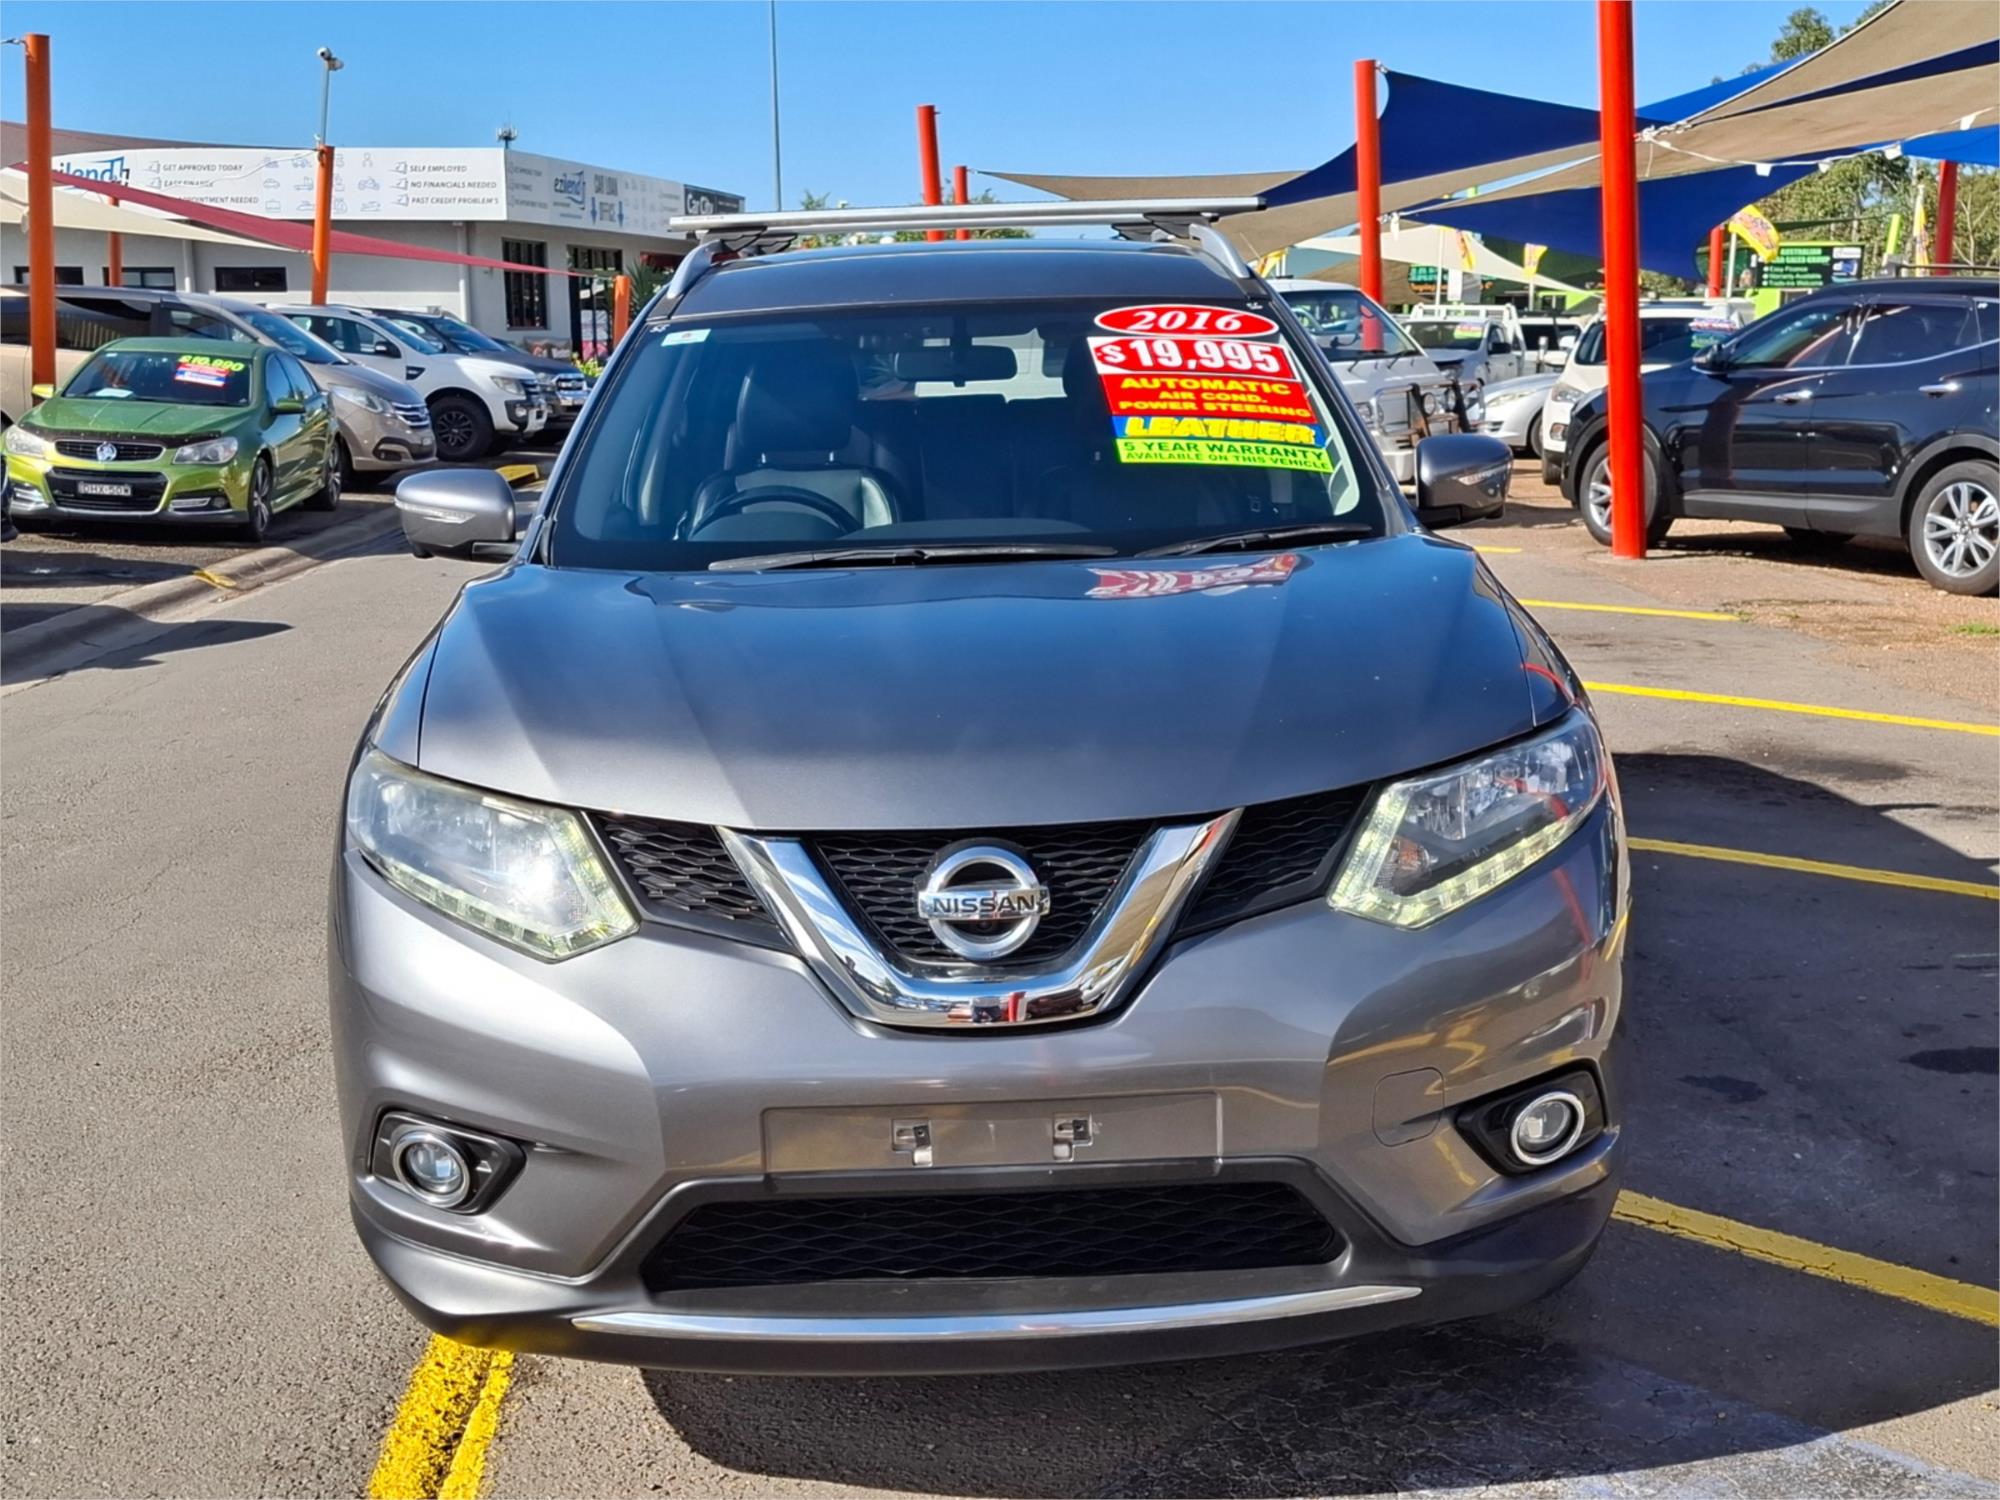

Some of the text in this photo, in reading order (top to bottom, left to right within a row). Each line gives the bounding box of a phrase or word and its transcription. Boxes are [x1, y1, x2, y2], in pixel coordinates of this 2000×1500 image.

[178, 164, 217, 172] APPROVED
[428, 165, 467, 173] EMPLOYED
[410, 181, 422, 189] NO
[424, 181, 466, 189] FINANCIALS
[230, 196, 259, 204] NEEDED
[1126, 310, 1243, 331] 2016
[1120, 377, 1291, 395] AUTOMATIC
[1158, 391, 1268, 404] AIR COND.
[1118, 401, 1311, 418] POWER STEERING
[1125, 416, 1316, 445] LEATHER
[1124, 441, 1324, 461] 5 YEAR WARRANTY
[1126, 452, 1330, 470] AVAILABLE ON THIS VEHICLE
[933, 894, 1035, 913] NISSAN
